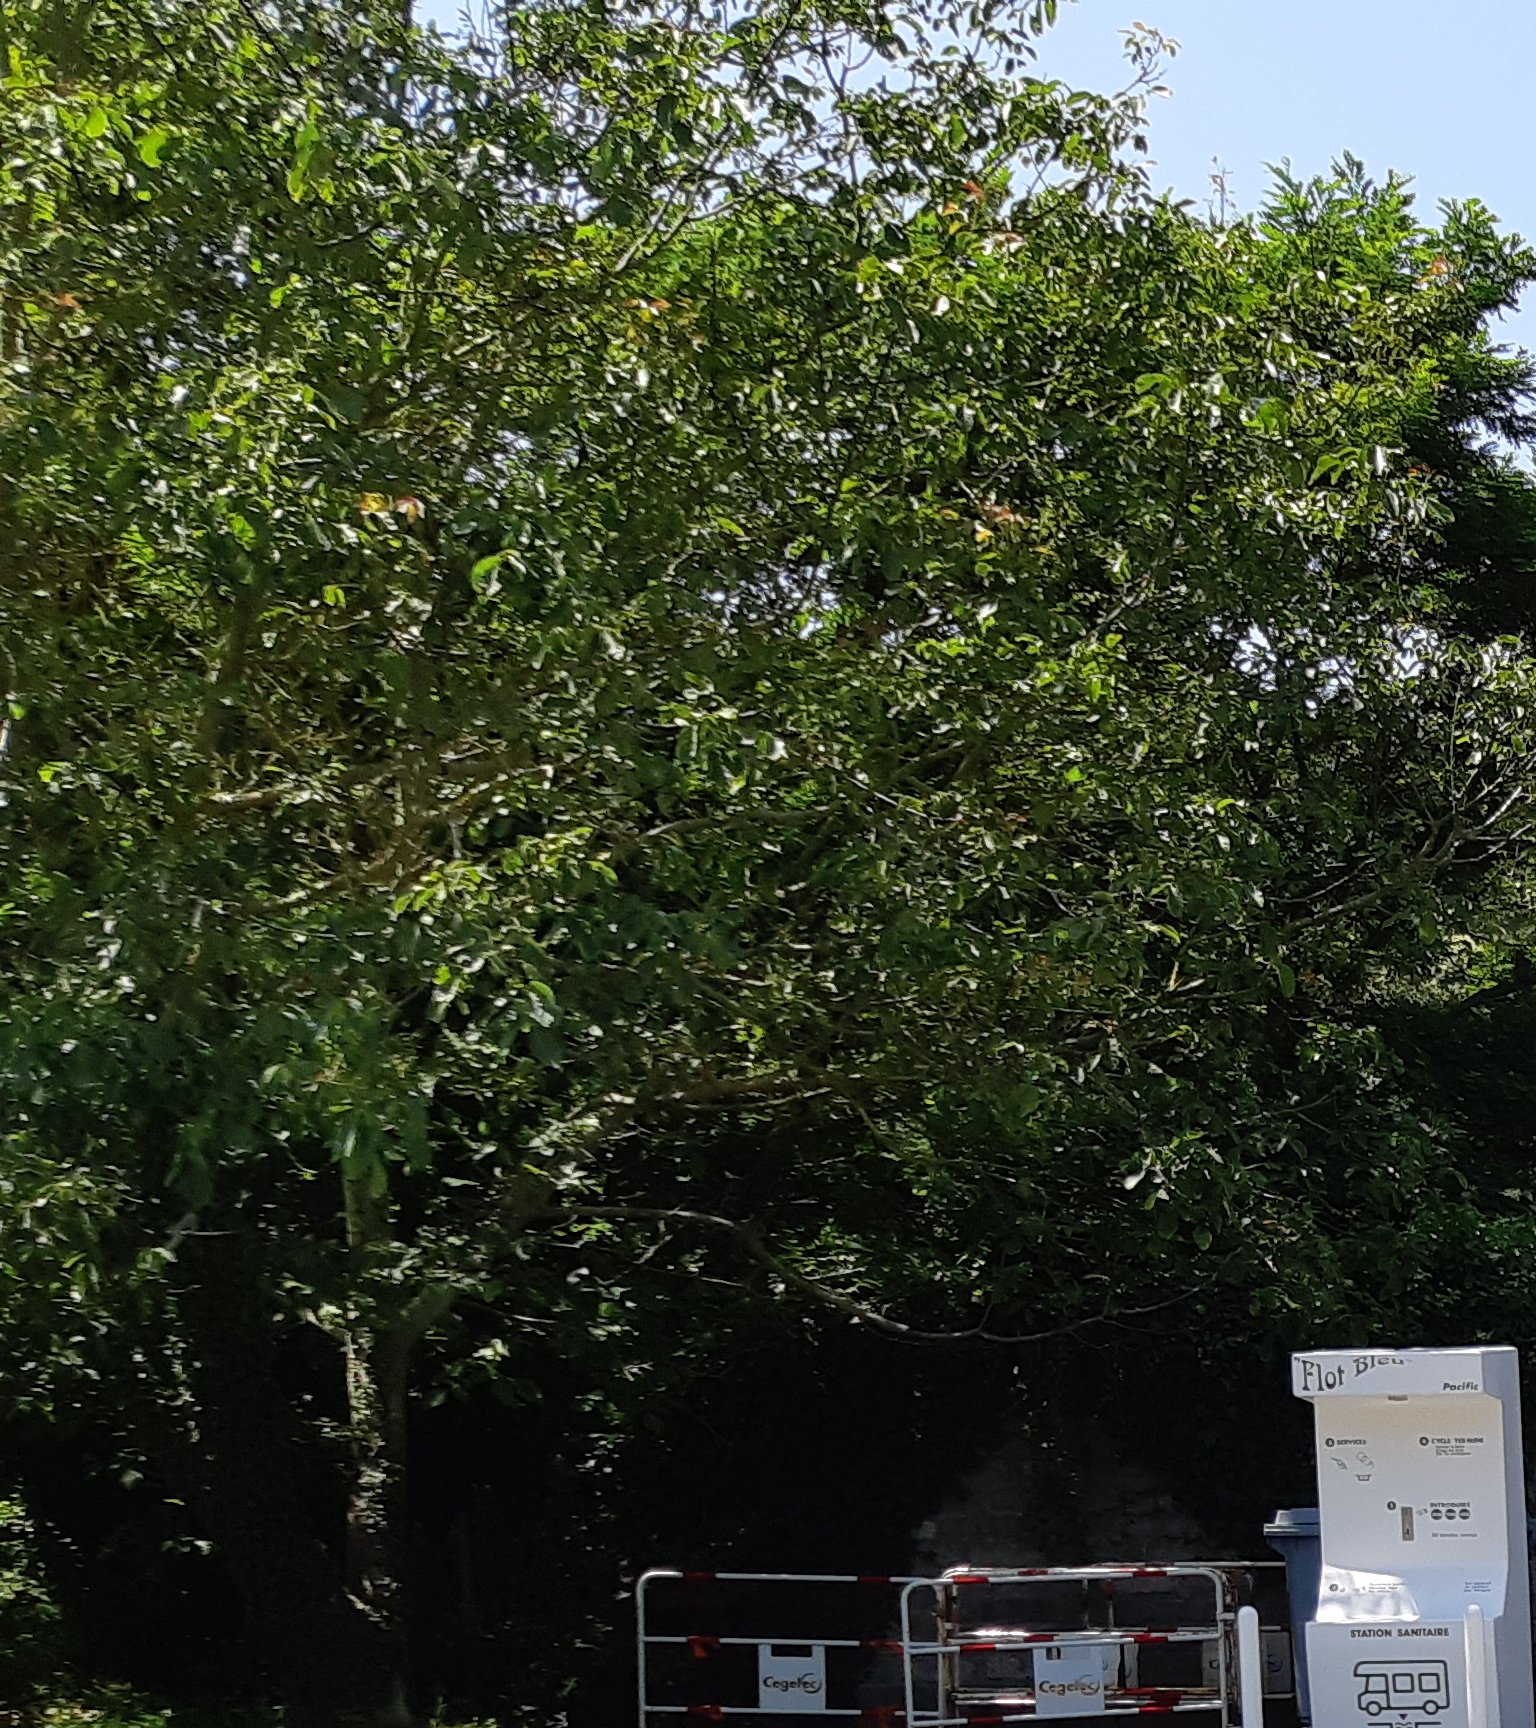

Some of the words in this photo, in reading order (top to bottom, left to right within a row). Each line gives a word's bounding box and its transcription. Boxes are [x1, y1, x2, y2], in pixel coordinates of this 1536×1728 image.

[1443, 1382, 1479, 1391] Pacific
[1350, 1629, 1393, 1638] STATION
[1398, 1627, 1449, 1637] SANITAIRE
